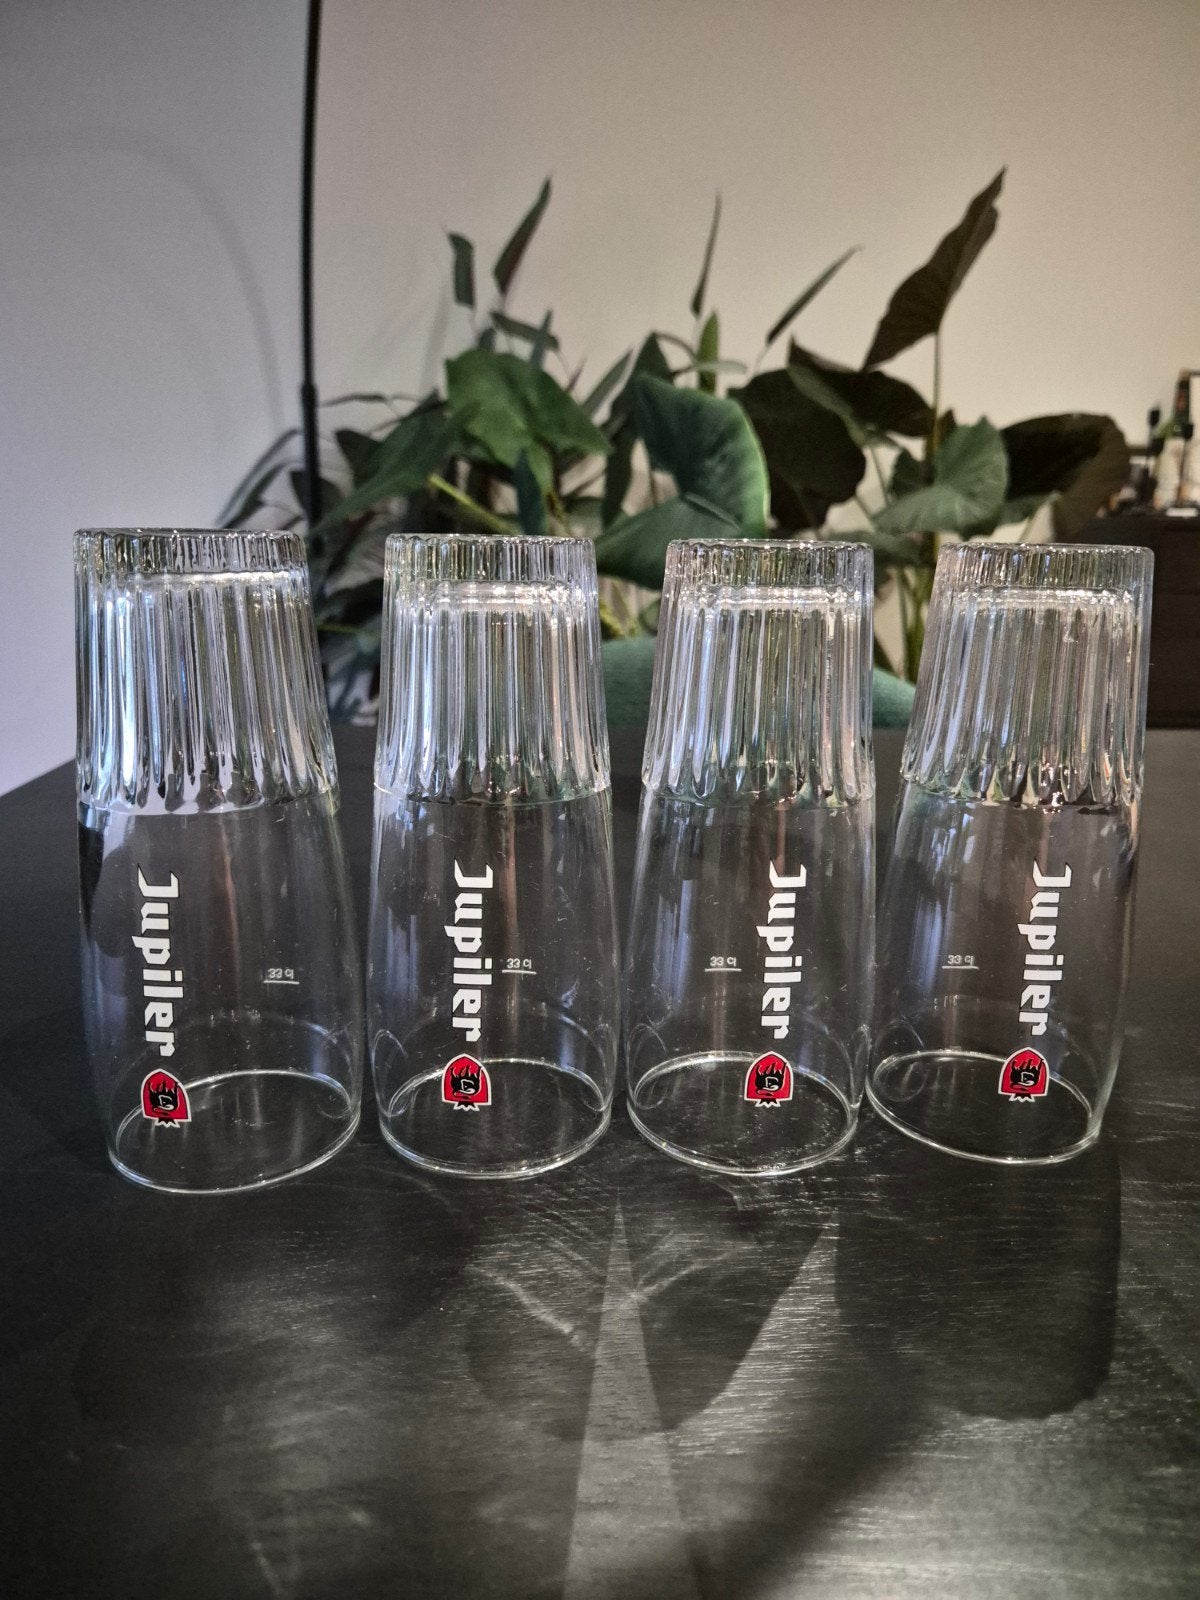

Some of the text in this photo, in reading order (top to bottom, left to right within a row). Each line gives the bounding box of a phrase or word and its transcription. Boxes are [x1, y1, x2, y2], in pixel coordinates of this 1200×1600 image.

[132, 864, 184, 1057] Jupiler
[444, 858, 494, 1042] Jupiler
[756, 858, 807, 1040] Jupiler
[1018, 859, 1072, 1036] Jupiler
